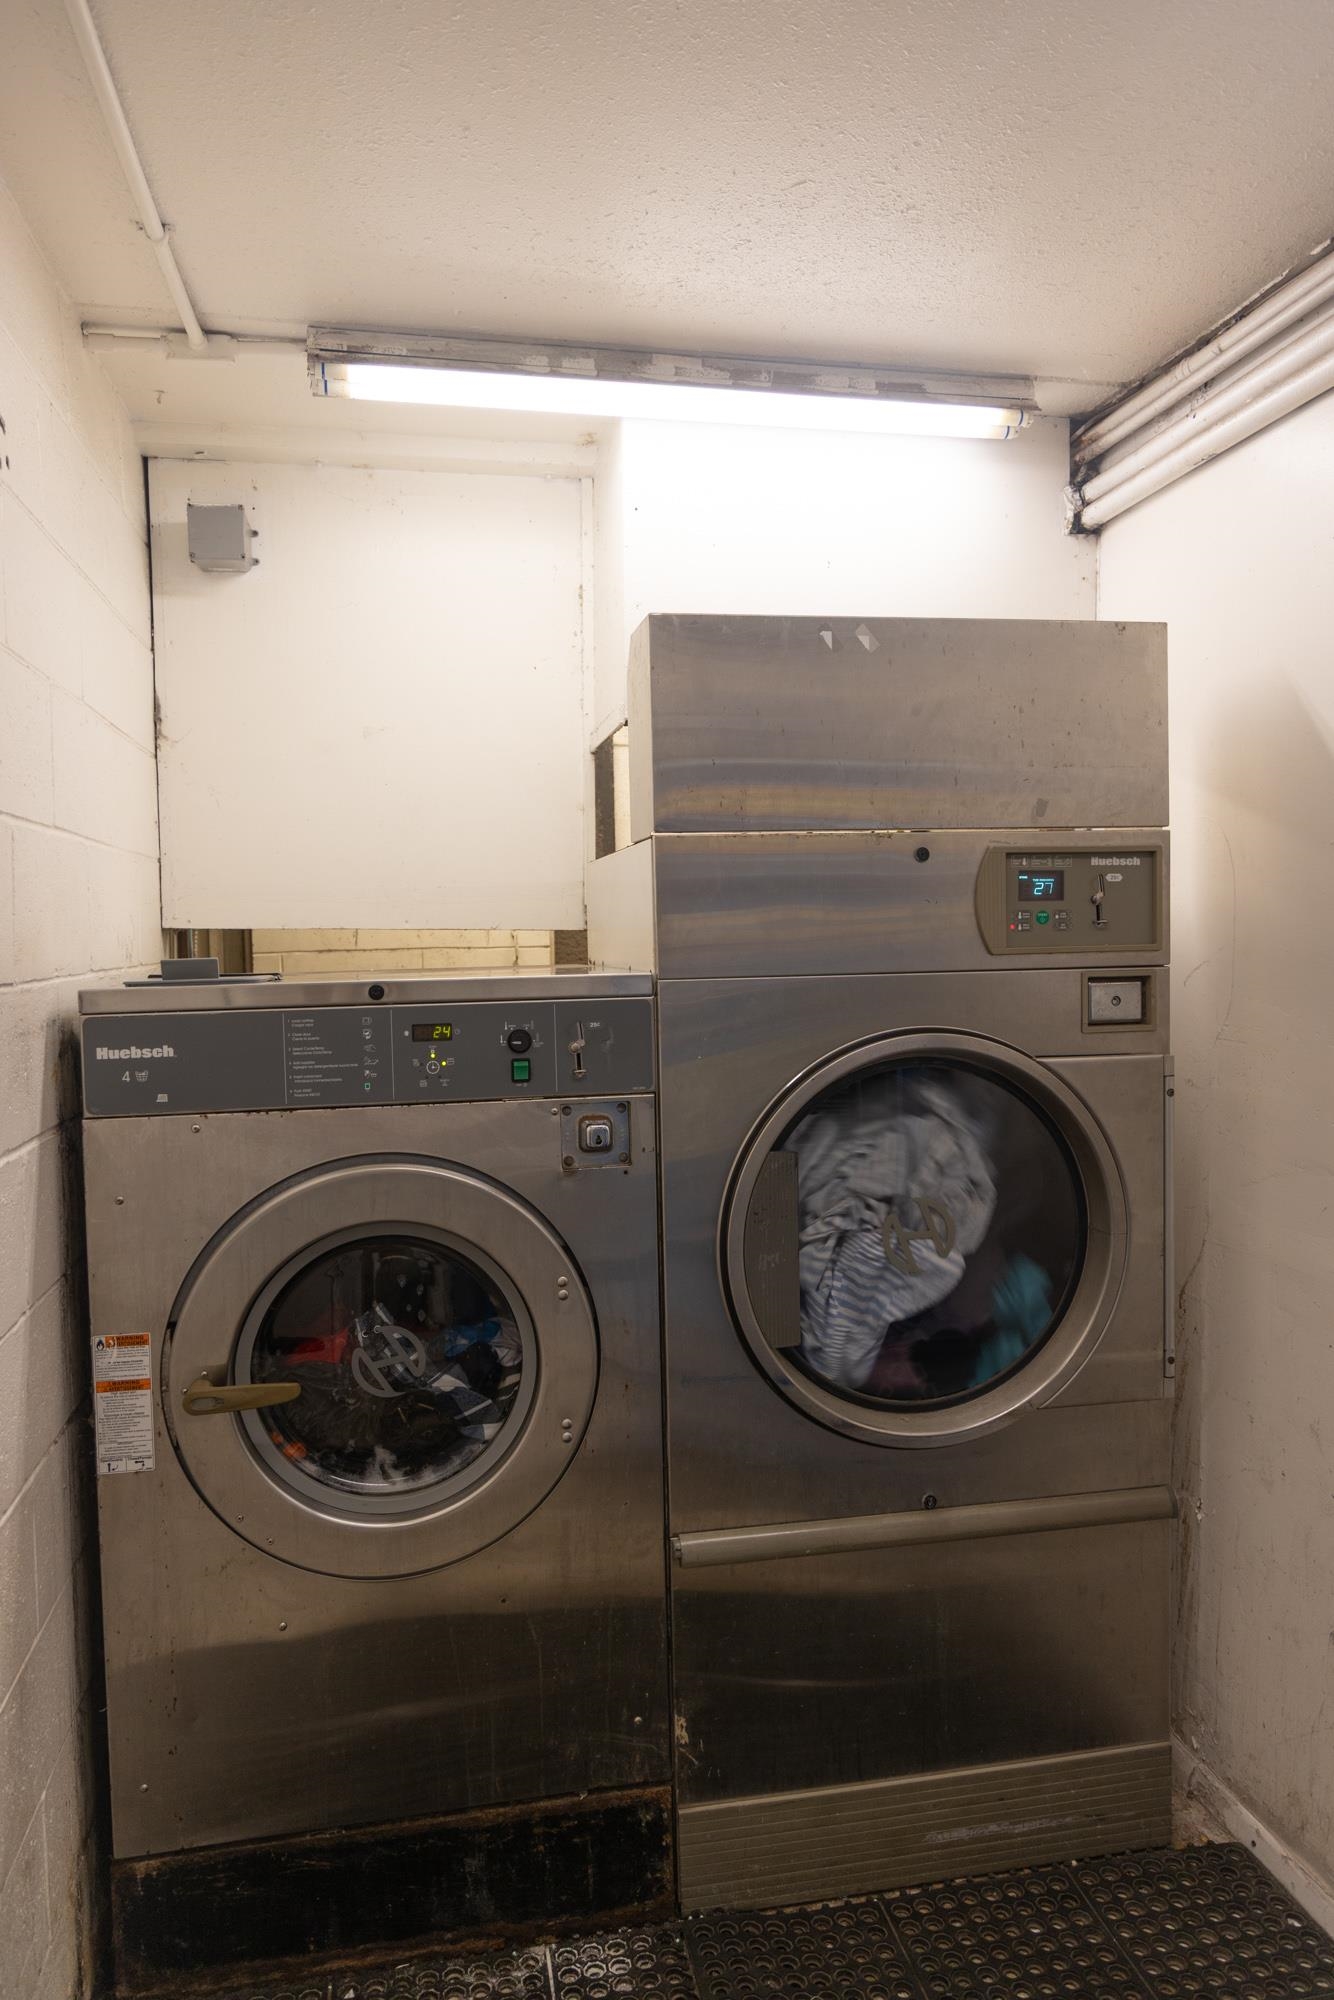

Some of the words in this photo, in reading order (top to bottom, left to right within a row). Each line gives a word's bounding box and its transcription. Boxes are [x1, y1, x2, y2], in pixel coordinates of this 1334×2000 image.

[1091, 857, 1140, 866] Huebsch
[1033, 882, 1053, 895] 27
[433, 1026, 451, 1038] 24
[96, 1045, 174, 1060] Huebsch
[122, 1071, 131, 1082] 4
